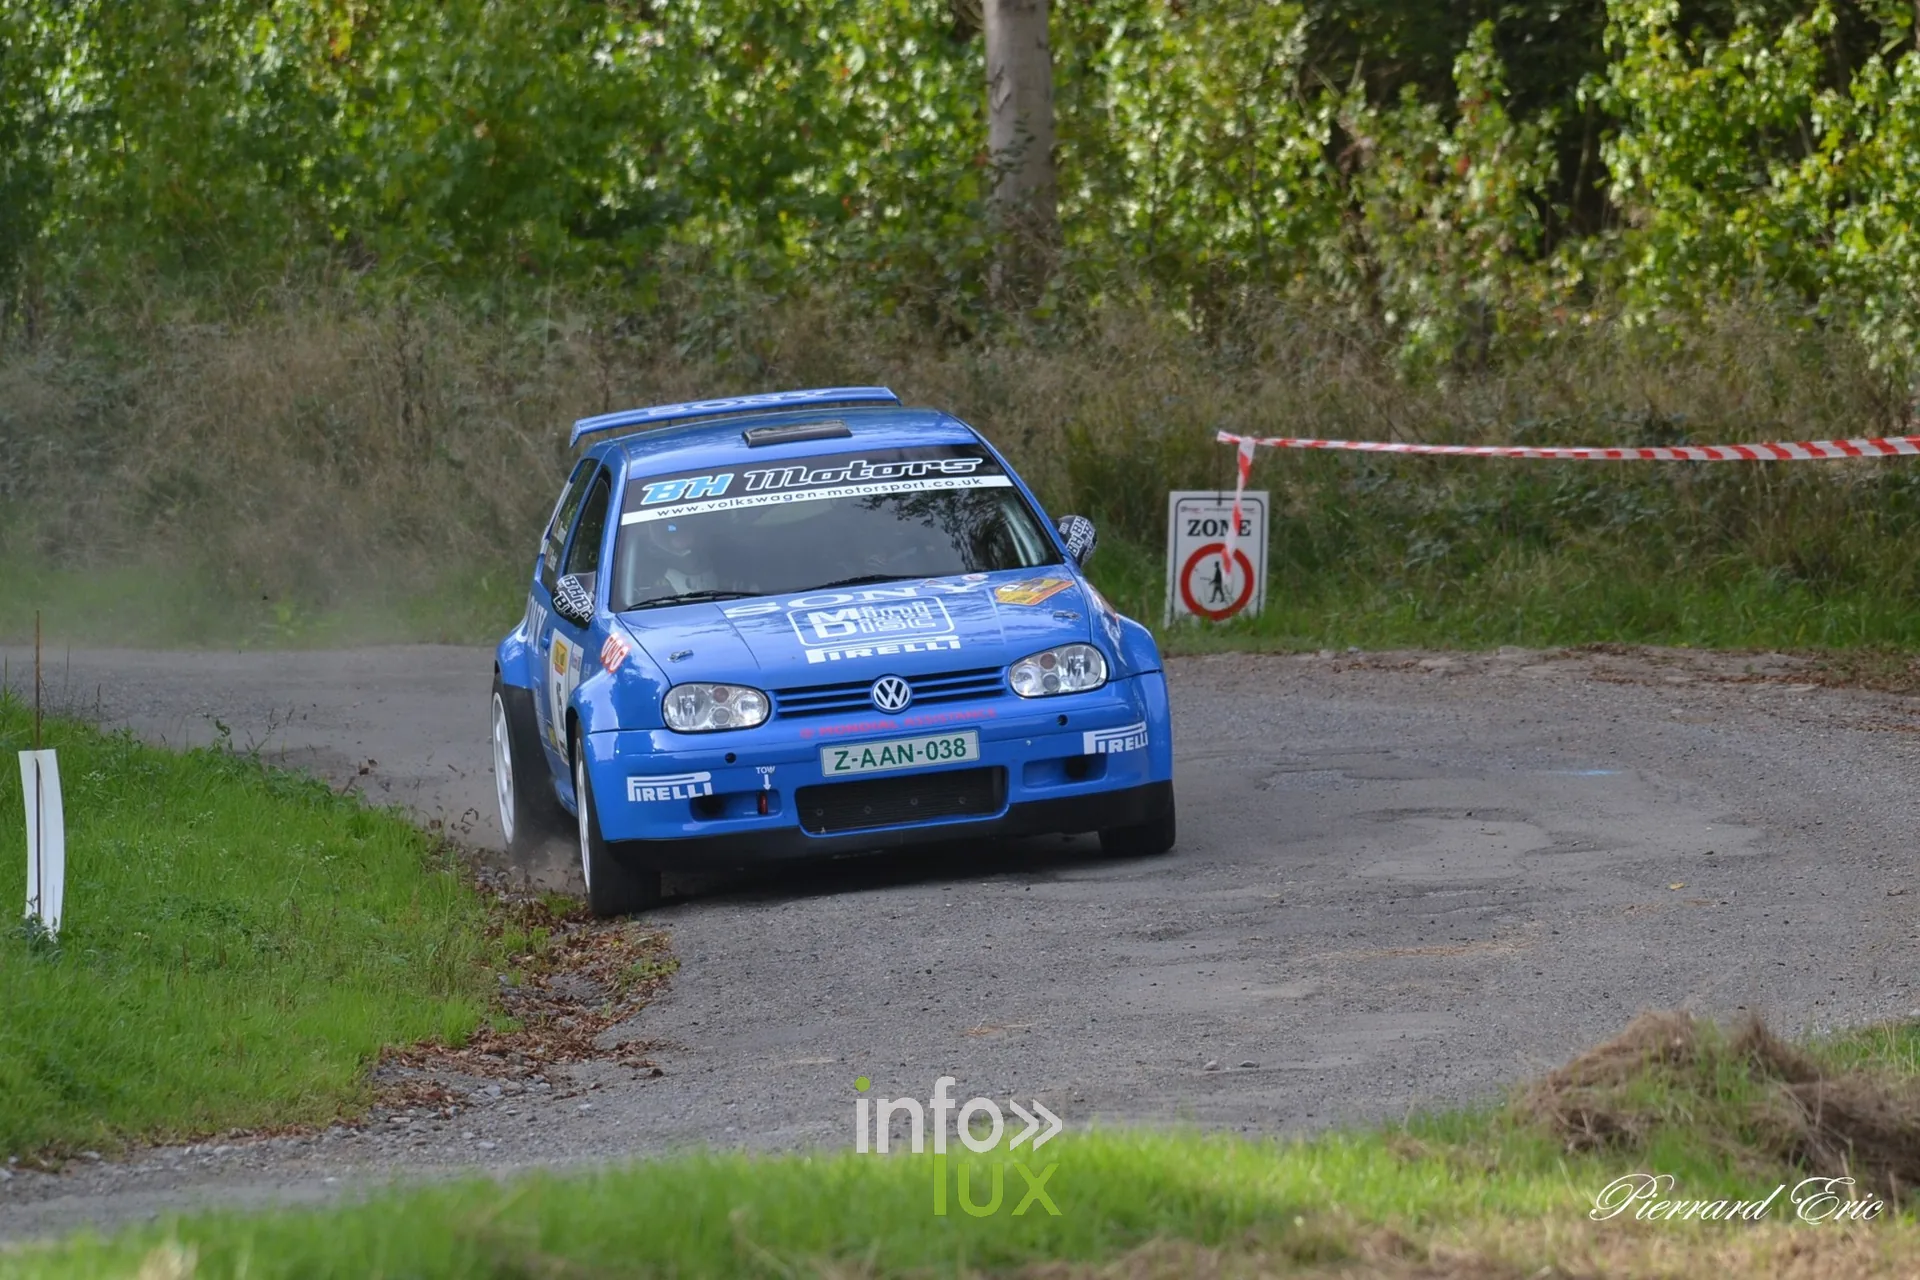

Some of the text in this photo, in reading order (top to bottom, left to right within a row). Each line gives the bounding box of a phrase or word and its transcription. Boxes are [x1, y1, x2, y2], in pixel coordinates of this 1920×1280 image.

[640, 458, 983, 506] BH Motors
[656, 477, 984, 518] www.volkswagen-motorsport.co.uk
[724, 580, 989, 619] SONY
[805, 635, 961, 664] PIRELLI
[819, 720, 899, 738] MONDIAL
[1083, 721, 1149, 755] PIRELLI
[756, 766, 776, 774] TOW
[834, 738, 967, 771] Z-AAN-038
[627, 771, 713, 802] PIRELLI
